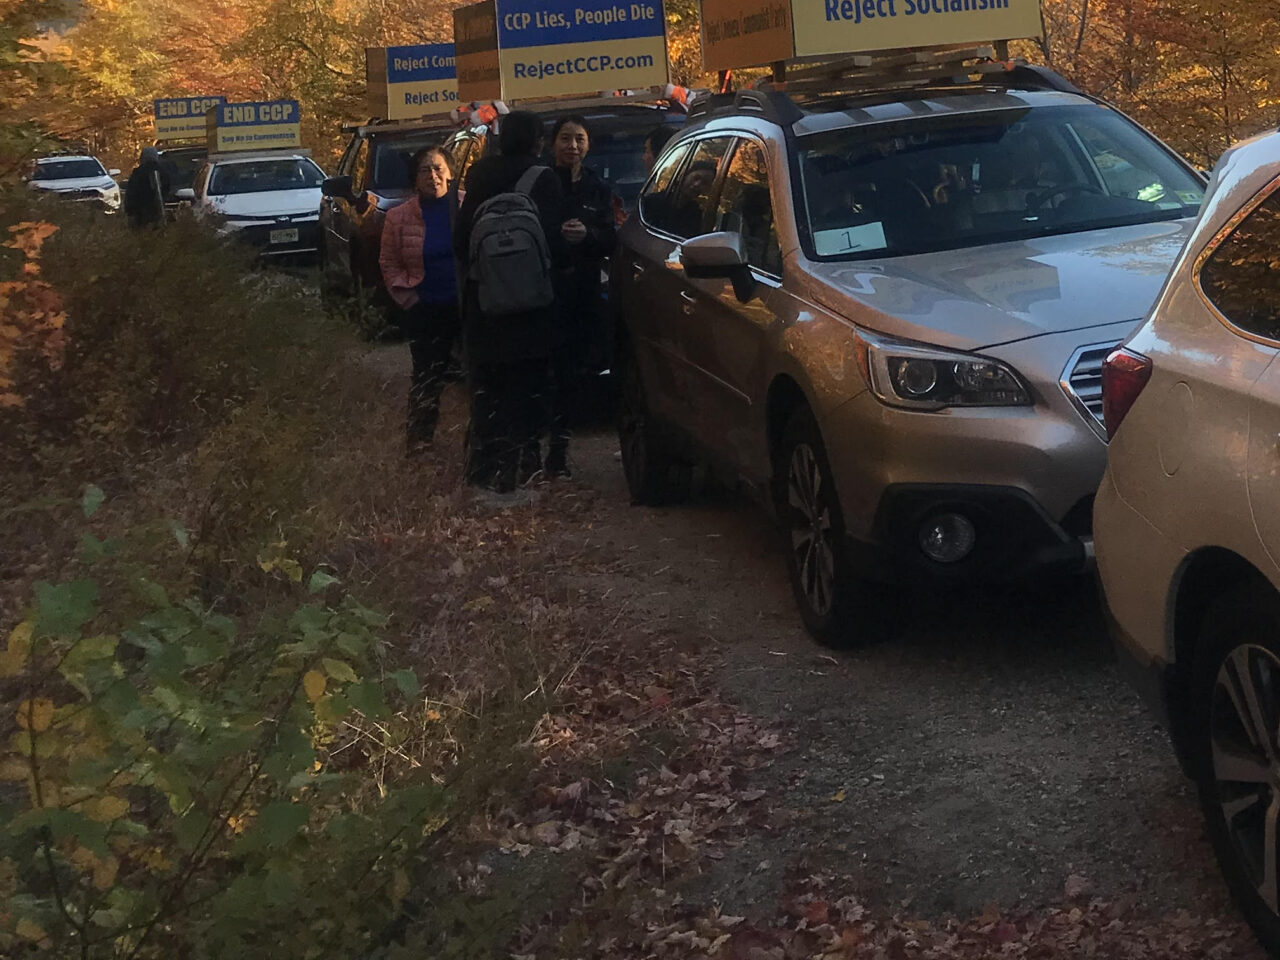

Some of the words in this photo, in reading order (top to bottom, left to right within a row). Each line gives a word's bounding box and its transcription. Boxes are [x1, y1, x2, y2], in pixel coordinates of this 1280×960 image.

[504, 12, 532, 31] CCP
[535, 11, 571, 29] Lies,
[575, 4, 627, 26] People
[630, 3, 655, 21] Die
[393, 56, 429, 72] Reject
[513, 53, 654, 80] RejectCCP.com
[158, 100, 188, 117] END
[404, 91, 439, 106] Reject
[223, 106, 256, 124] END
[259, 103, 293, 122] CCP
[839, 231, 862, 252] 1
